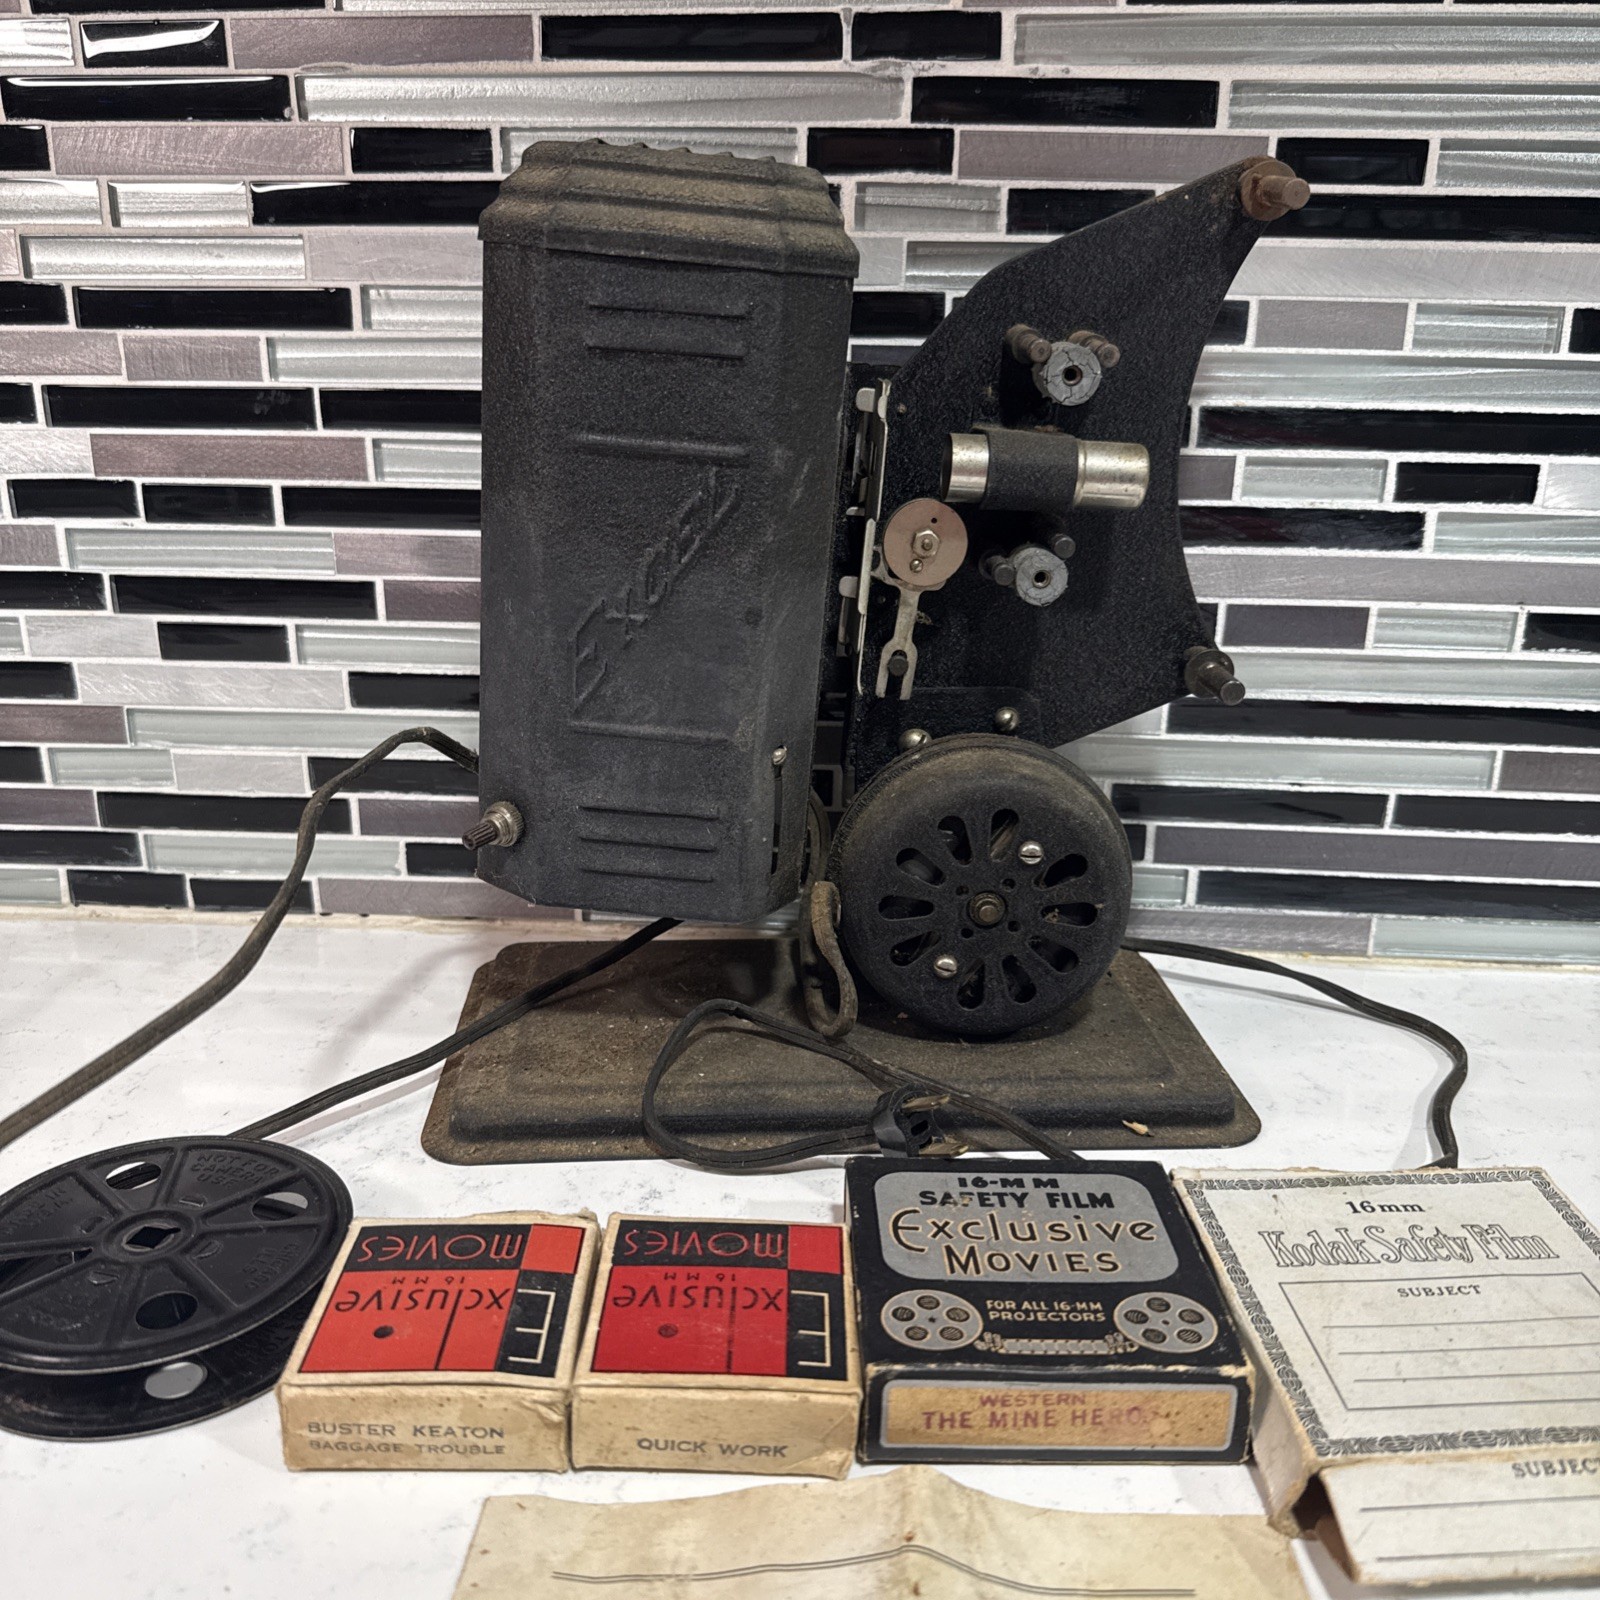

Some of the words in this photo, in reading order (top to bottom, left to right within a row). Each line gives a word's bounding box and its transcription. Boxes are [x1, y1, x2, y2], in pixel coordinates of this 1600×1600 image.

[918, 1189, 1030, 1209] SAFETY
[1045, 1191, 1116, 1210] FILM
[889, 1207, 1158, 1255] Exclusive
[356, 1233, 523, 1262] MOVIES
[623, 1229, 784, 1259] MOVIES
[1257, 1226, 1381, 1268] Kodak
[1362, 1223, 1475, 1264] Safety
[1460, 1222, 1561, 1261] Film
[942, 1242, 1122, 1277] MOVIES
[444, 1276, 465, 1286] 16
[714, 1272, 737, 1282] 16
[1396, 1284, 1482, 1298] SUBJECT
[985, 1299, 1017, 1311] FOR
[1020, 1299, 1050, 1311] ALL
[988, 1310, 1107, 1322] PROJECTORS
[979, 1392, 1087, 1408] WESTERN
[922, 1410, 974, 1430] THE
[988, 1408, 1059, 1429] MINE
[307, 1421, 397, 1437] BUSTER
[412, 1424, 506, 1440] KEATON
[308, 1439, 403, 1453] BAGGAGE
[413, 1442, 506, 1456] TROUBLE
[636, 1436, 707, 1454] QUICK
[711, 1442, 789, 1458] WORK
[1511, 1457, 1600, 1479] SUBJEC
